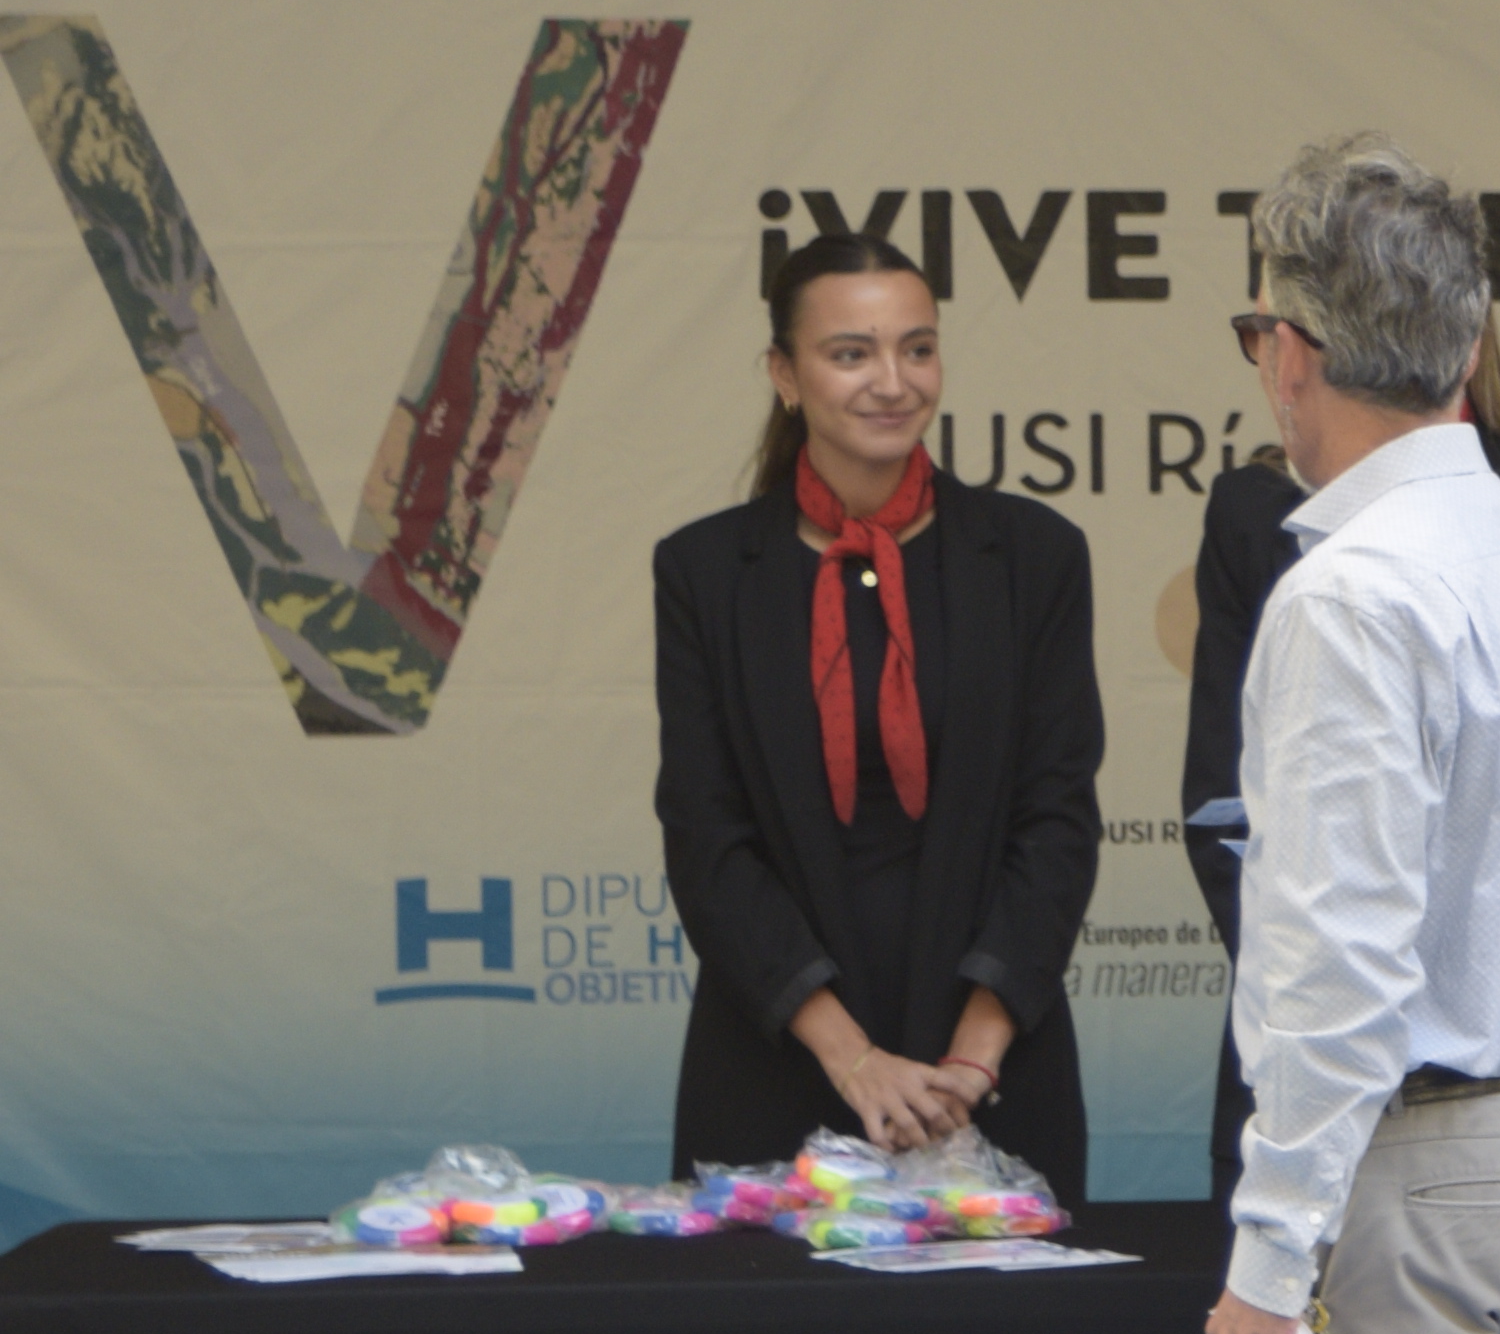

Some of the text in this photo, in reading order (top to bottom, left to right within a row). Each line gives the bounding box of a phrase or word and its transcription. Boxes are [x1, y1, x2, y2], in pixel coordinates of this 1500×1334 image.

[940, 412, 1105, 495] USI
[541, 925, 614, 970] DE
[1175, 921, 1202, 945] de
[1091, 961, 1227, 998] manera
